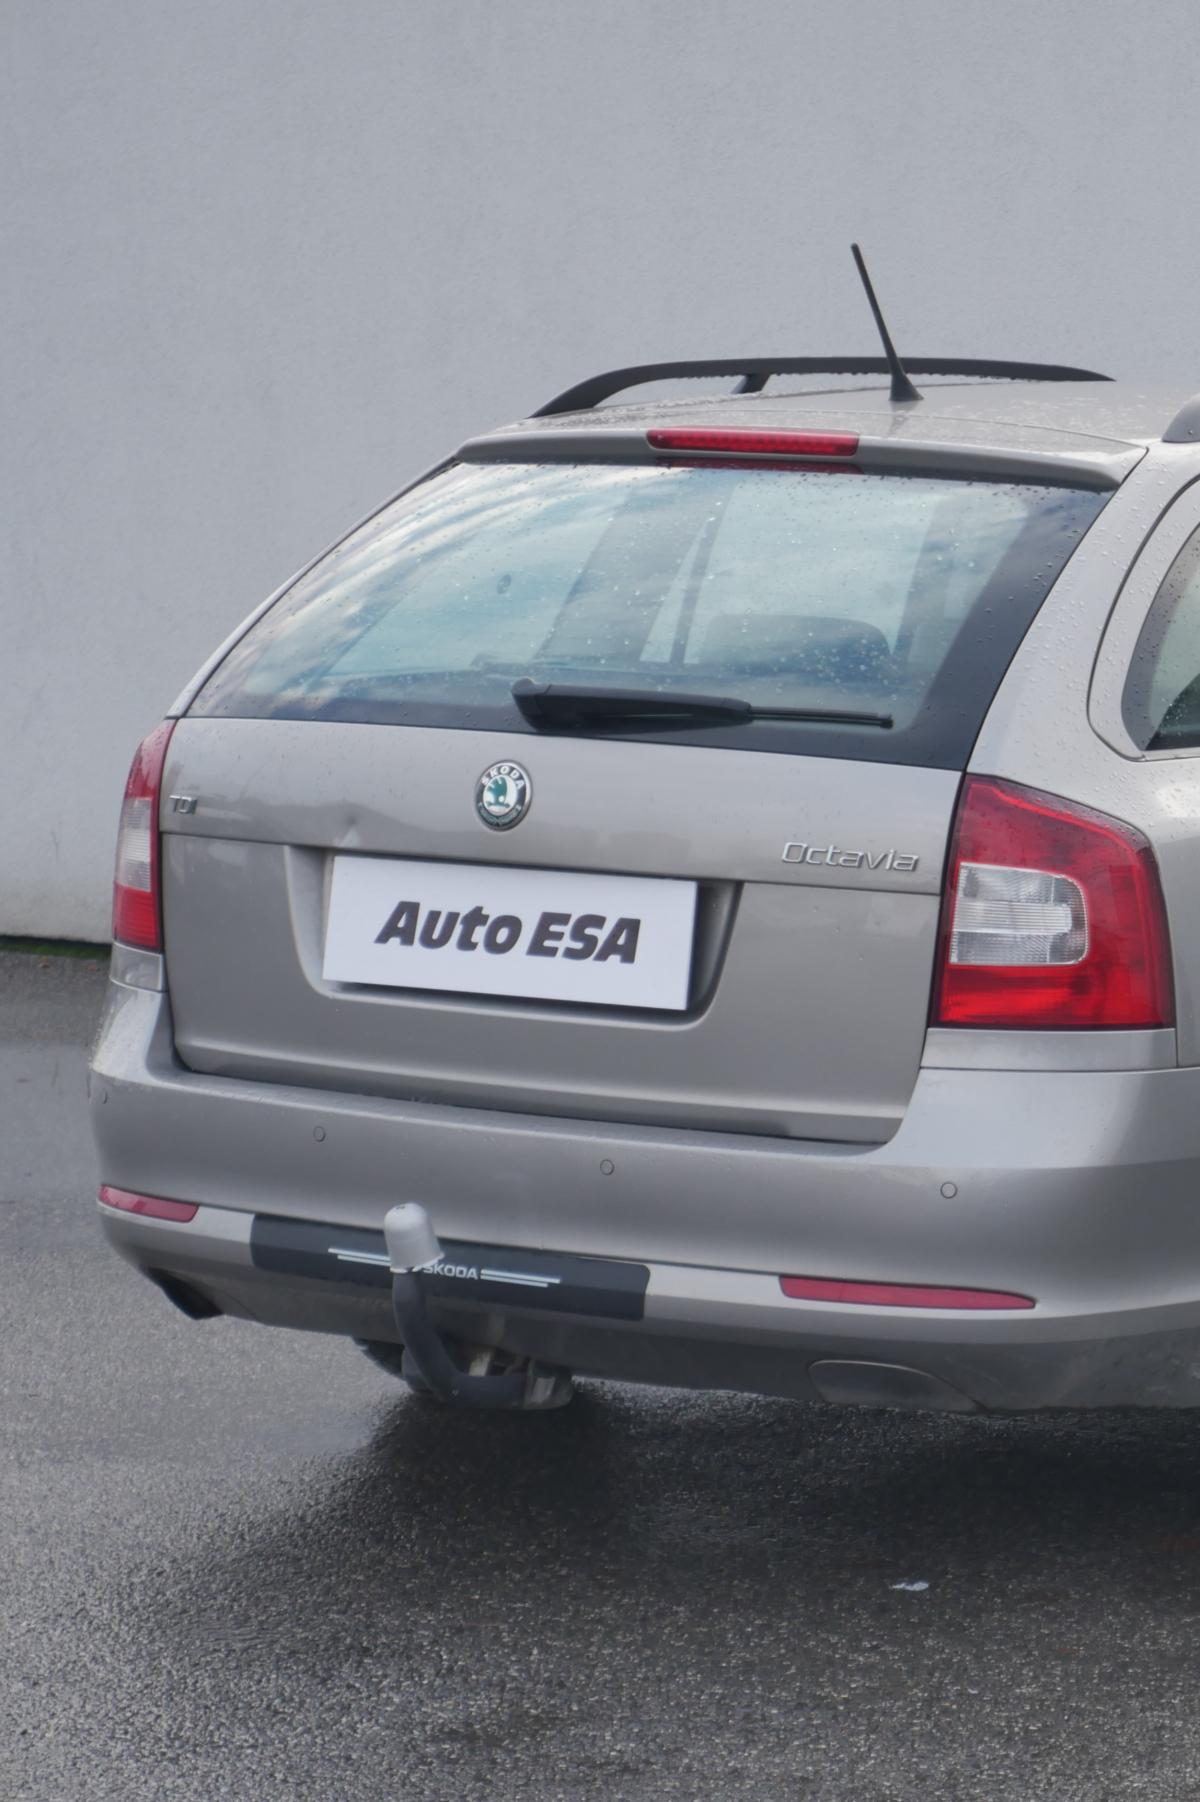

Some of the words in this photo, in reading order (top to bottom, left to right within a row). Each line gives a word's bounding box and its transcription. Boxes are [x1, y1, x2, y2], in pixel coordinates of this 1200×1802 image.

[782, 842, 921, 872] Octavia
[374, 901, 523, 955] Auto
[526, 912, 642, 964] ESA
